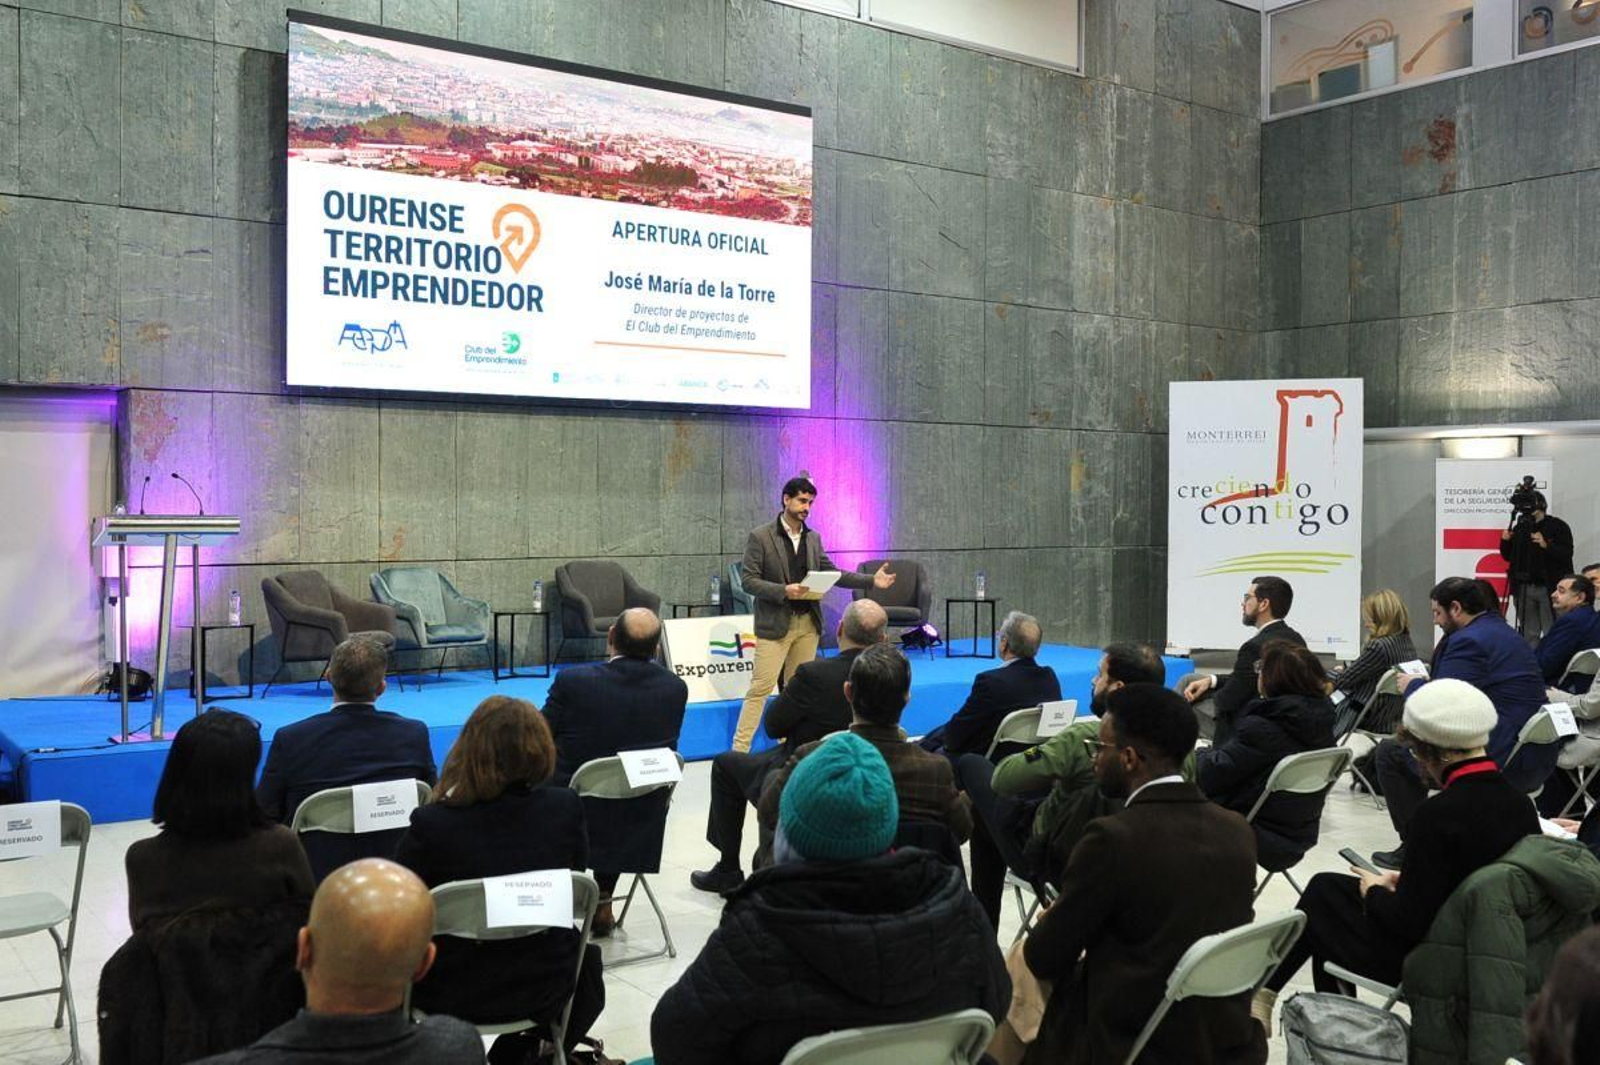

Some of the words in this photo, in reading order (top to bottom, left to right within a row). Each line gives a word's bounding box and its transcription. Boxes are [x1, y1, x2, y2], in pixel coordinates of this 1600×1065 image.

[323, 190, 465, 234] OURENSE
[612, 220, 703, 248] APERTURA
[707, 231, 769, 255] OFICIAL
[323, 228, 502, 274] TERRITORIO
[323, 266, 544, 312] EMPRENDEDOR
[604, 270, 643, 290] José
[648, 274, 692, 295] María
[697, 280, 716, 298] de
[720, 281, 734, 299] la
[738, 284, 776, 303] Torre
[634, 303, 672, 317] Director
[675, 306, 687, 318] de
[689, 309, 735, 323] proyectos
[738, 312, 749, 323] de
[625, 319, 635, 331] El
[638, 321, 660, 333] Club
[663, 323, 678, 335] del
[681, 324, 756, 341] Emprendimiento
[464, 344, 483, 354] Club
[484, 345, 497, 355] del
[464, 354, 527, 366] Emprendimiento
[1186, 430, 1266, 440] MONTERREI
[1177, 469, 1312, 499] creciendo
[1444, 488, 1485, 496] TESORERÍA
[1487, 488, 1513, 496] GENER
[1444, 497, 1455, 505] DE
[1456, 497, 1467, 505] LA
[1200, 499, 1350, 536] contigo
[674, 660, 754, 678] Expouren
[370, 809, 406, 818] RESERVADO
[504, 880, 553, 888] RESERVADO
